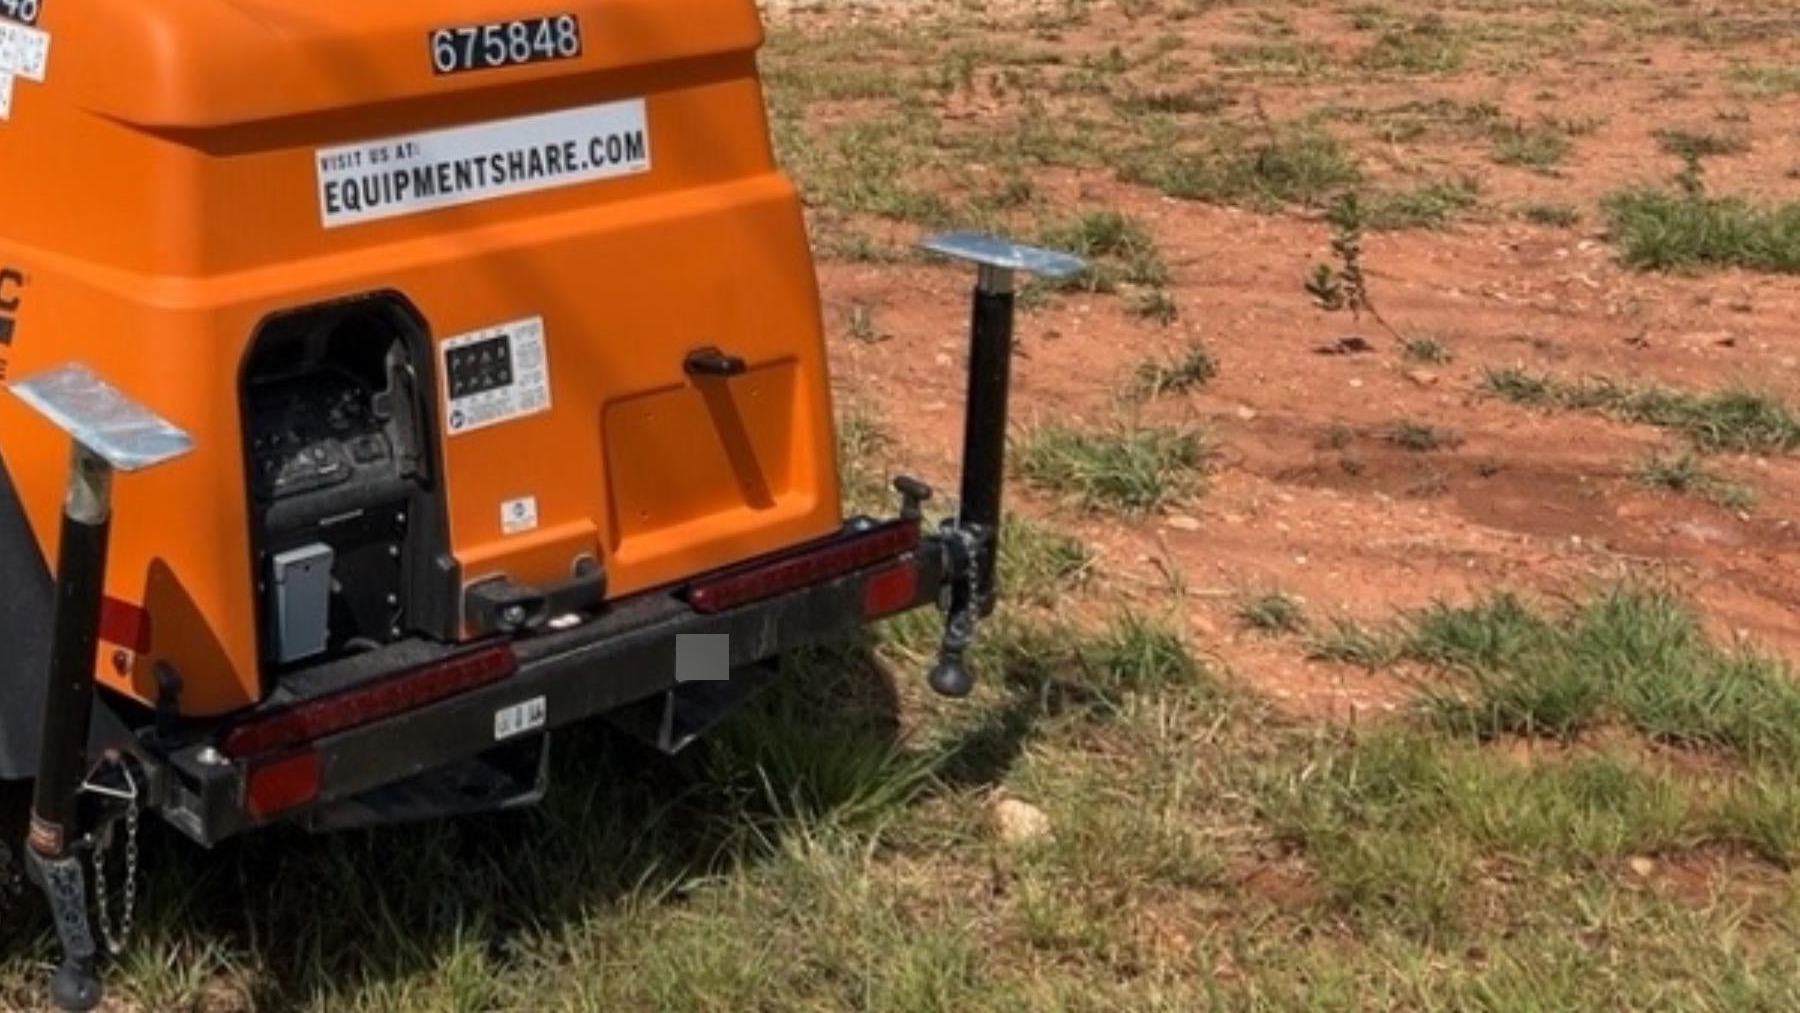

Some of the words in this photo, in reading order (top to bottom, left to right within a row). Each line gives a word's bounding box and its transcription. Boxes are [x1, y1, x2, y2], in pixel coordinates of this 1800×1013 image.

[432, 15, 579, 73] 675848
[320, 152, 362, 172] VISIT
[368, 146, 389, 163] US
[324, 129, 646, 215] EQUIPMENTSHARE.COM
